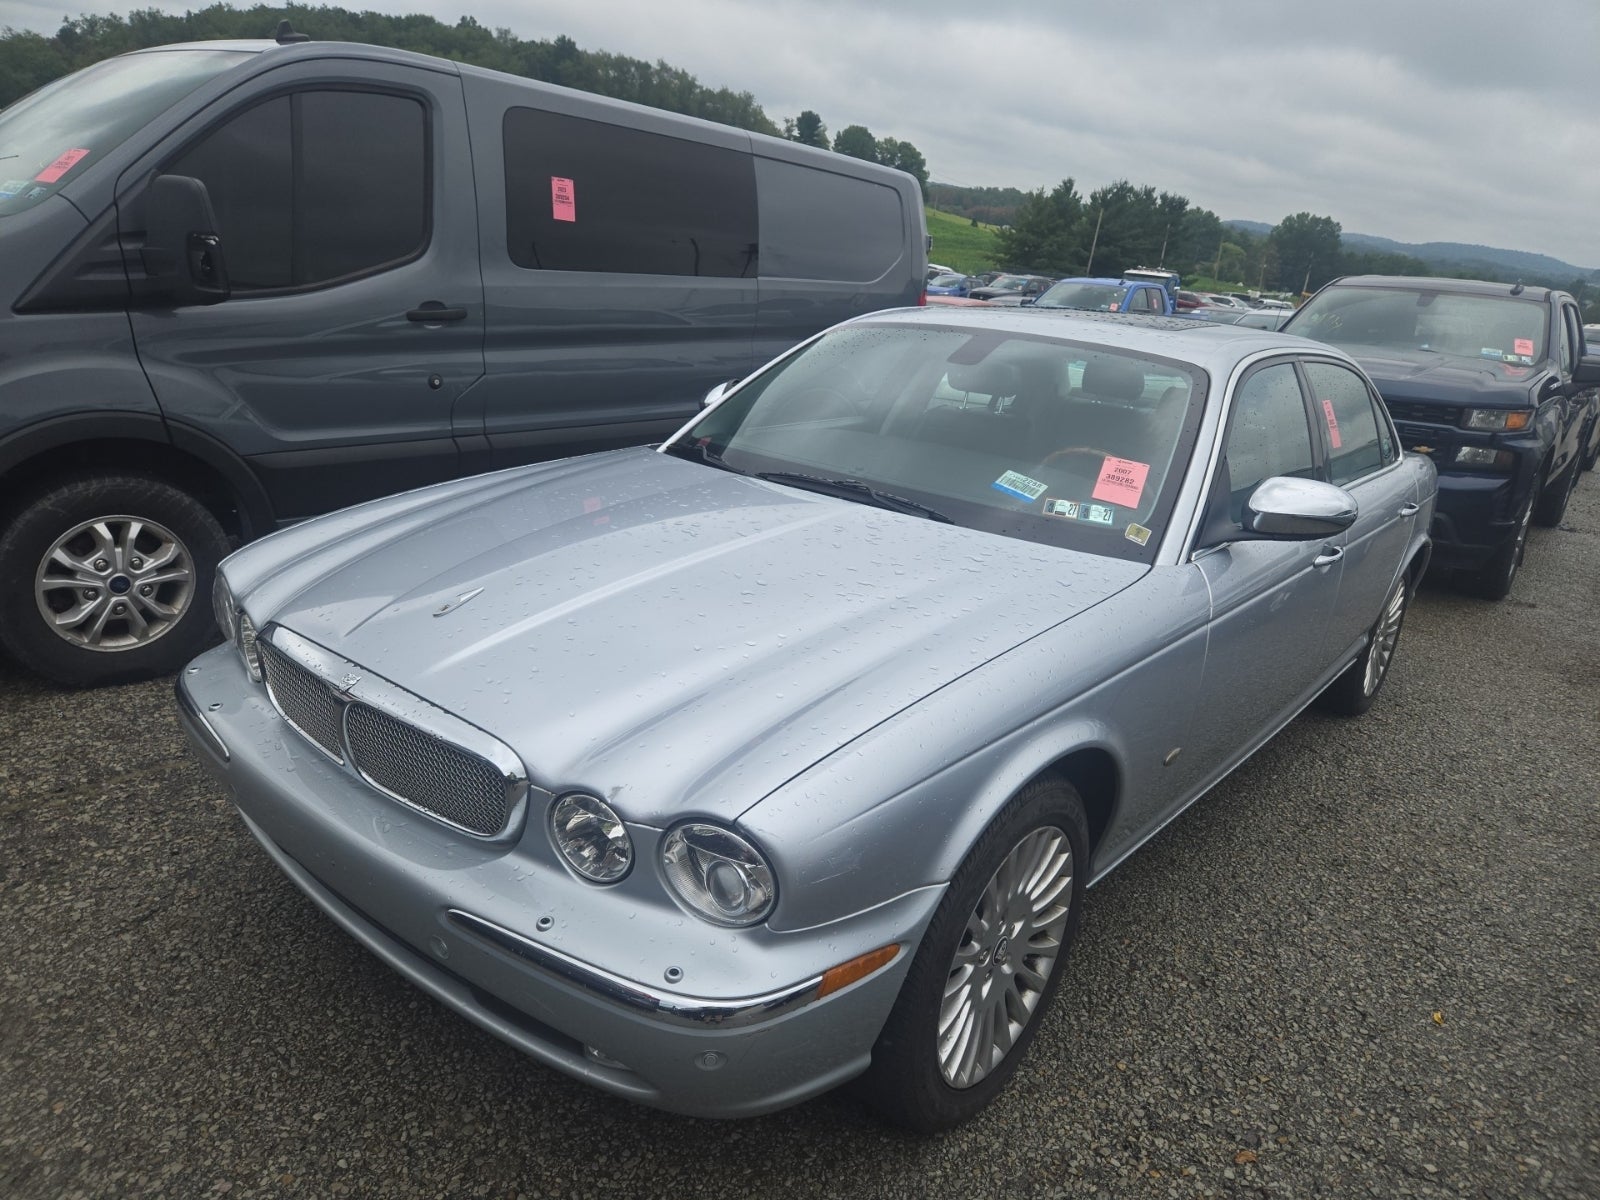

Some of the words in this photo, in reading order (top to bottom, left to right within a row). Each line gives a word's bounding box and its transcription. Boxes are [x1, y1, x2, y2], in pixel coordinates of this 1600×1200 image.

[1114, 467, 1132, 475] 2007
[1067, 503, 1078, 516] 27
[1103, 508, 1112, 522] 27
